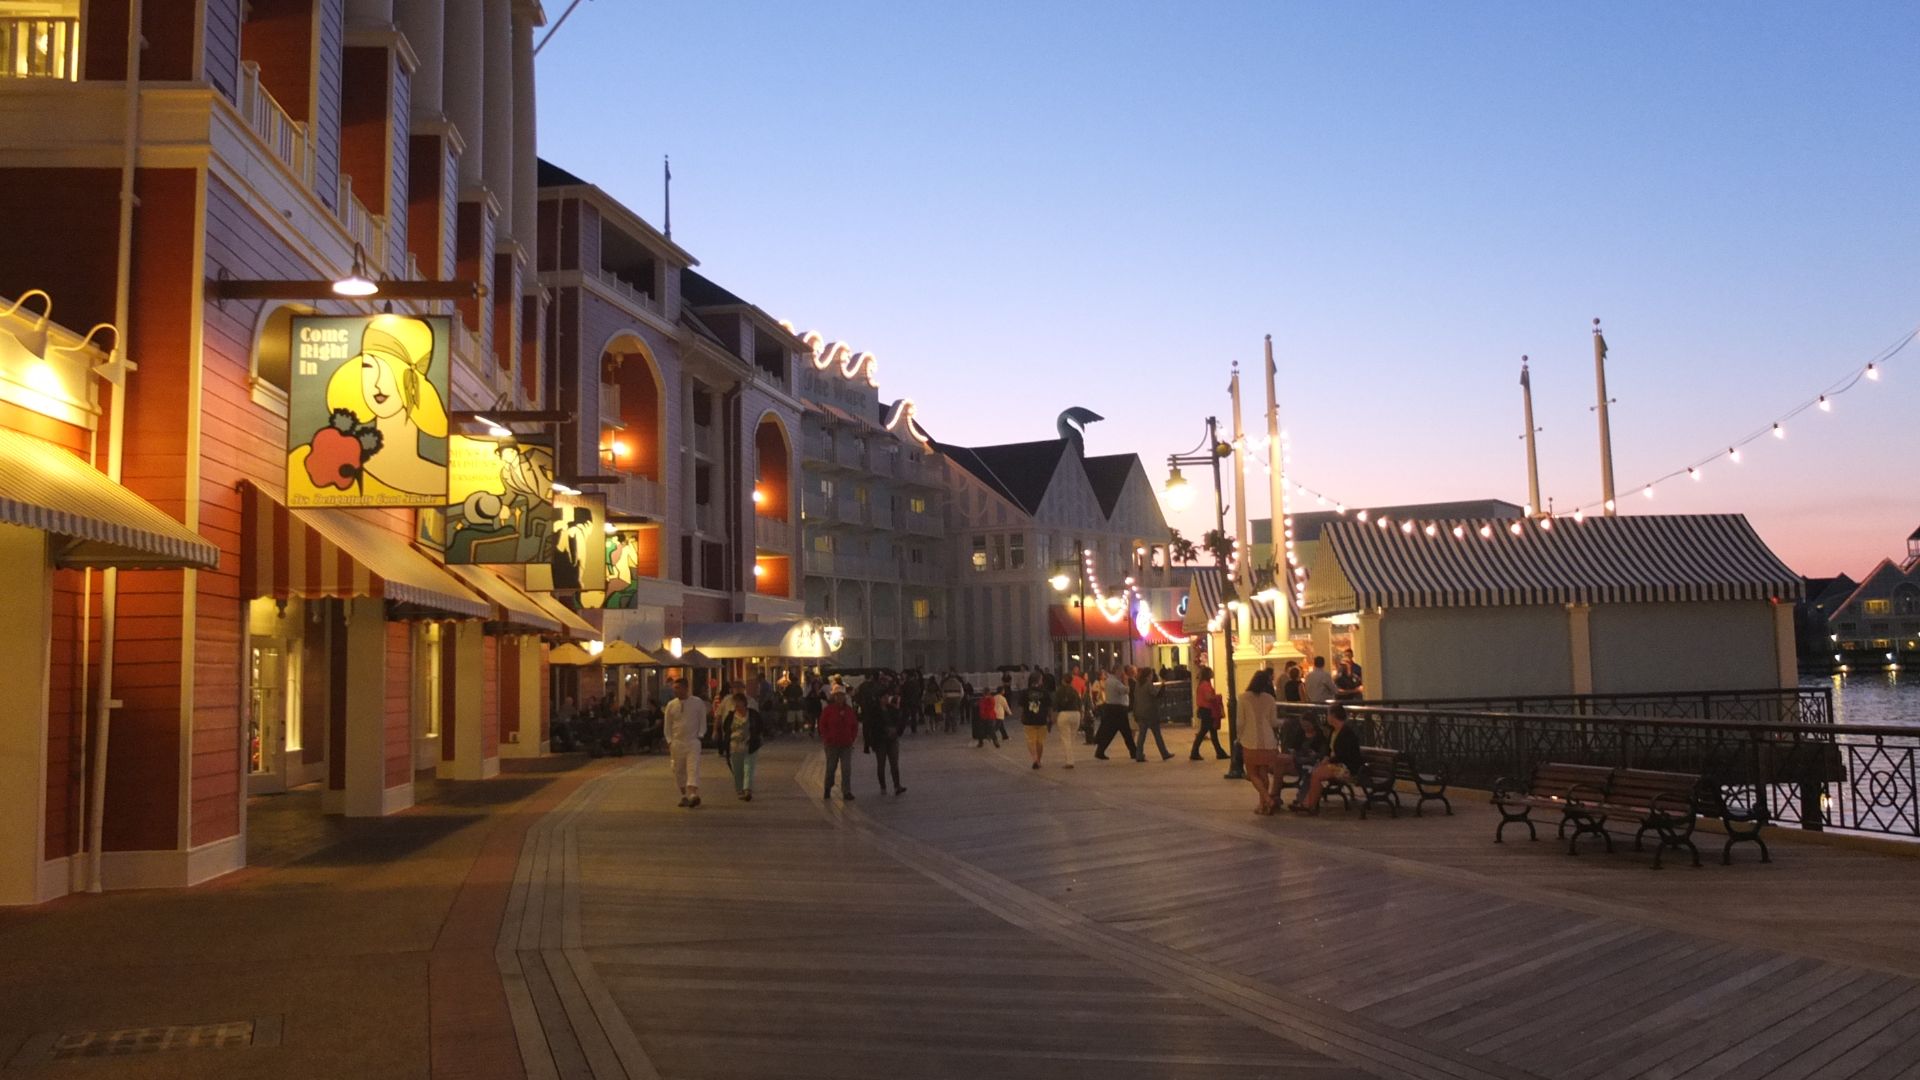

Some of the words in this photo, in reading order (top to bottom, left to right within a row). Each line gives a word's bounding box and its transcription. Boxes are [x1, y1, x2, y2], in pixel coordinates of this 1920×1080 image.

[300, 326, 348, 342] Come
[300, 342, 348, 361] Right
[299, 360, 318, 375] In
